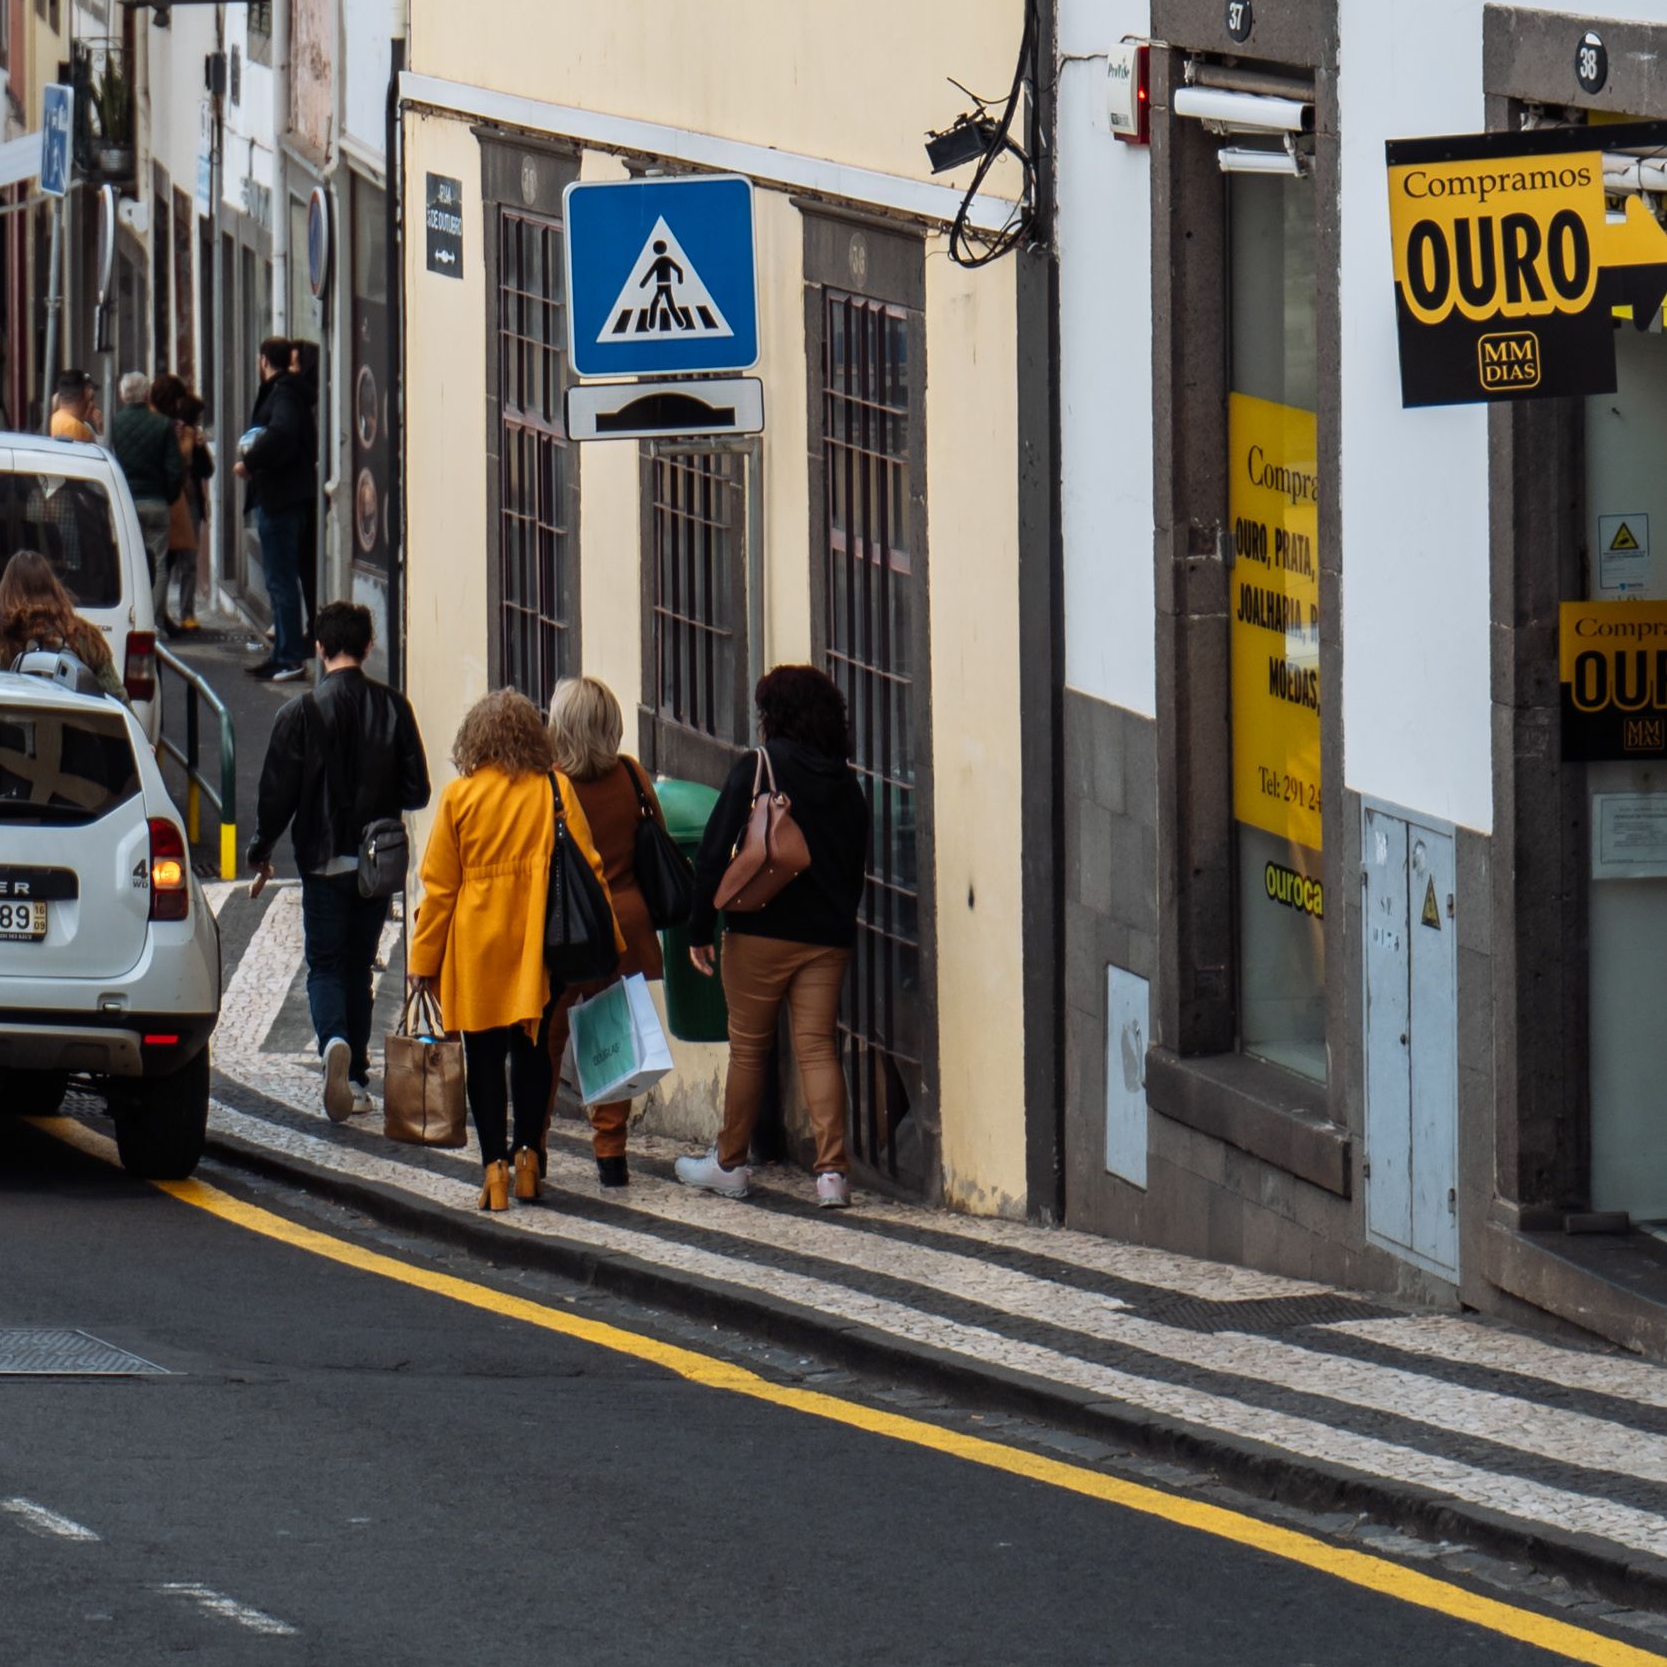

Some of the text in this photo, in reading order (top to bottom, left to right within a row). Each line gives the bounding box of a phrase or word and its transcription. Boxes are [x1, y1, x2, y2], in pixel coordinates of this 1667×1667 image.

[1228, 2, 1244, 31] 37
[1580, 47, 1598, 81] 38
[1402, 167, 1592, 203] Compramos
[1406, 208, 1591, 312] OURO
[1483, 339, 1534, 364] MM
[1485, 362, 1536, 383] DIAS
[1235, 517, 1316, 584] OURO, PRATA,
[1237, 582, 1307, 646] JOALHARIA,
[1268, 654, 1321, 718] MOEDAS,
[1628, 720, 1660, 735] MM
[1628, 733, 1661, 747] DIAS
[1259, 765, 1281, 799] Tel:
[1284, 775, 1304, 807] 291
[132, 858, 148, 878] 4
